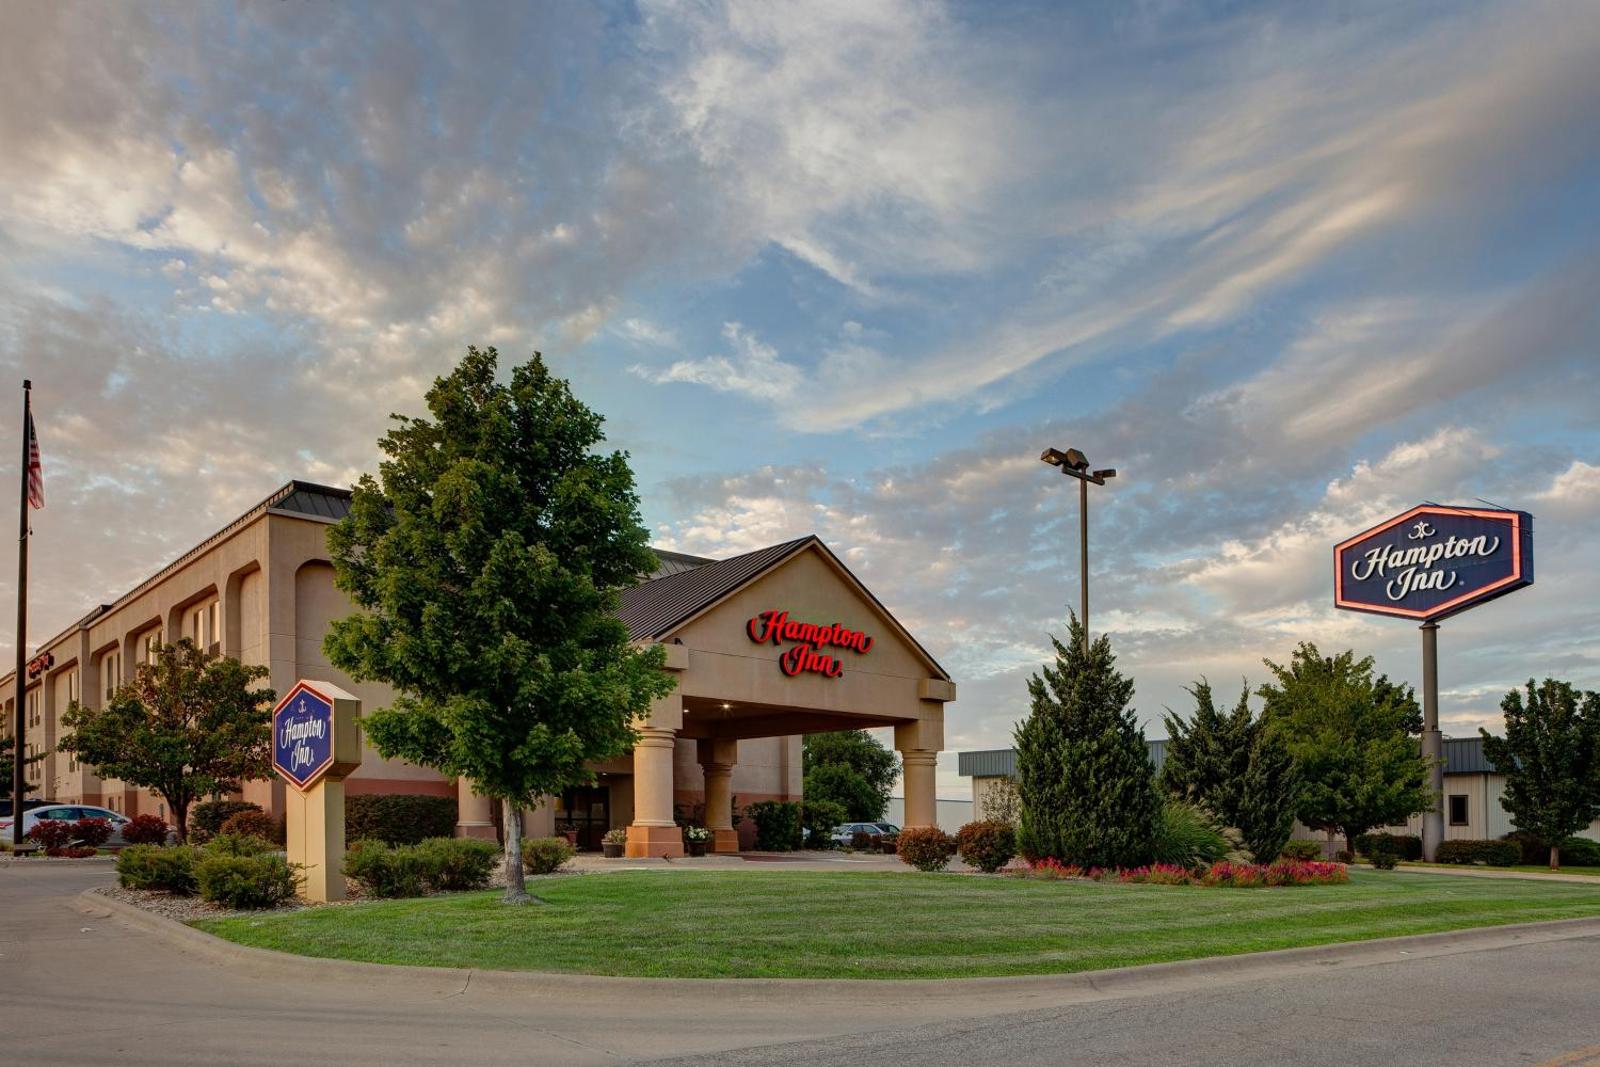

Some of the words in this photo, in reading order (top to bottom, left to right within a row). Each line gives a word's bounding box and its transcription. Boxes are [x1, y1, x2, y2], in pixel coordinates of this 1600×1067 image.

[1352, 535, 1500, 580] Hampton
[1386, 567, 1457, 601] Inn
[747, 610, 875, 654] Hampton
[779, 643, 843, 677] Inn
[281, 715, 326, 749] Hampton
[290, 740, 314, 772] Inn
